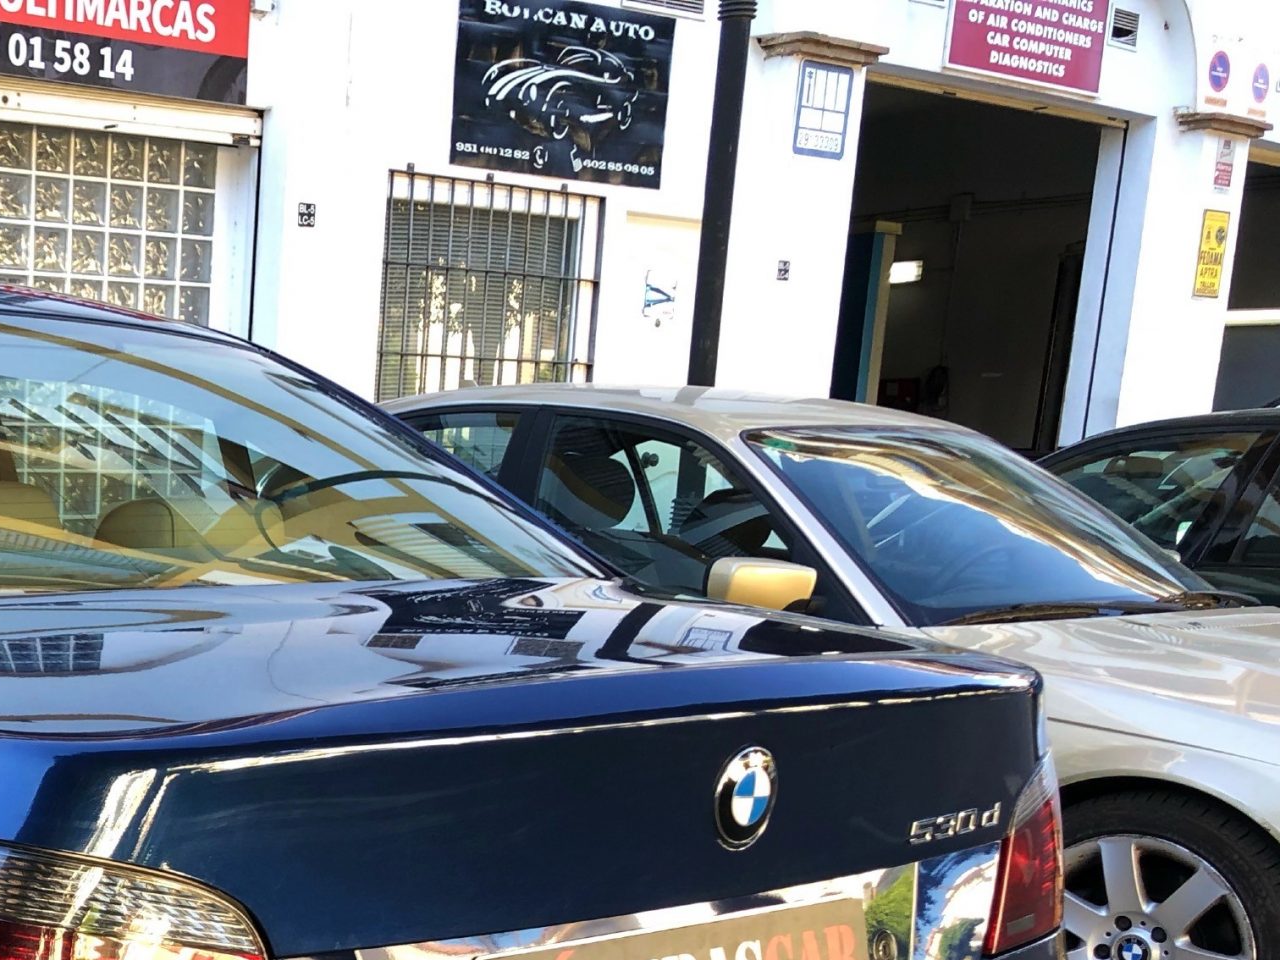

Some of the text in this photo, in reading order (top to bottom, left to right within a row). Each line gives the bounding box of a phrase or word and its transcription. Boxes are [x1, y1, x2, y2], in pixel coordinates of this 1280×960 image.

[590, 18, 655, 41] AUTO
[968, 8, 1092, 48] OF AIR CONDITIONERS
[1034, 5, 1059, 23] AND
[1062, 12, 1105, 34] CHARGE
[8, 32, 46, 70] 01
[53, 40, 91, 76] 58
[98, 47, 135, 82] 14
[986, 31, 1073, 61] CAR COMPUTER
[989, 50, 1066, 78] DIAGNOSTICS
[456, 141, 478, 154] 951
[513, 149, 530, 161] 82
[640, 165, 655, 177] 05
